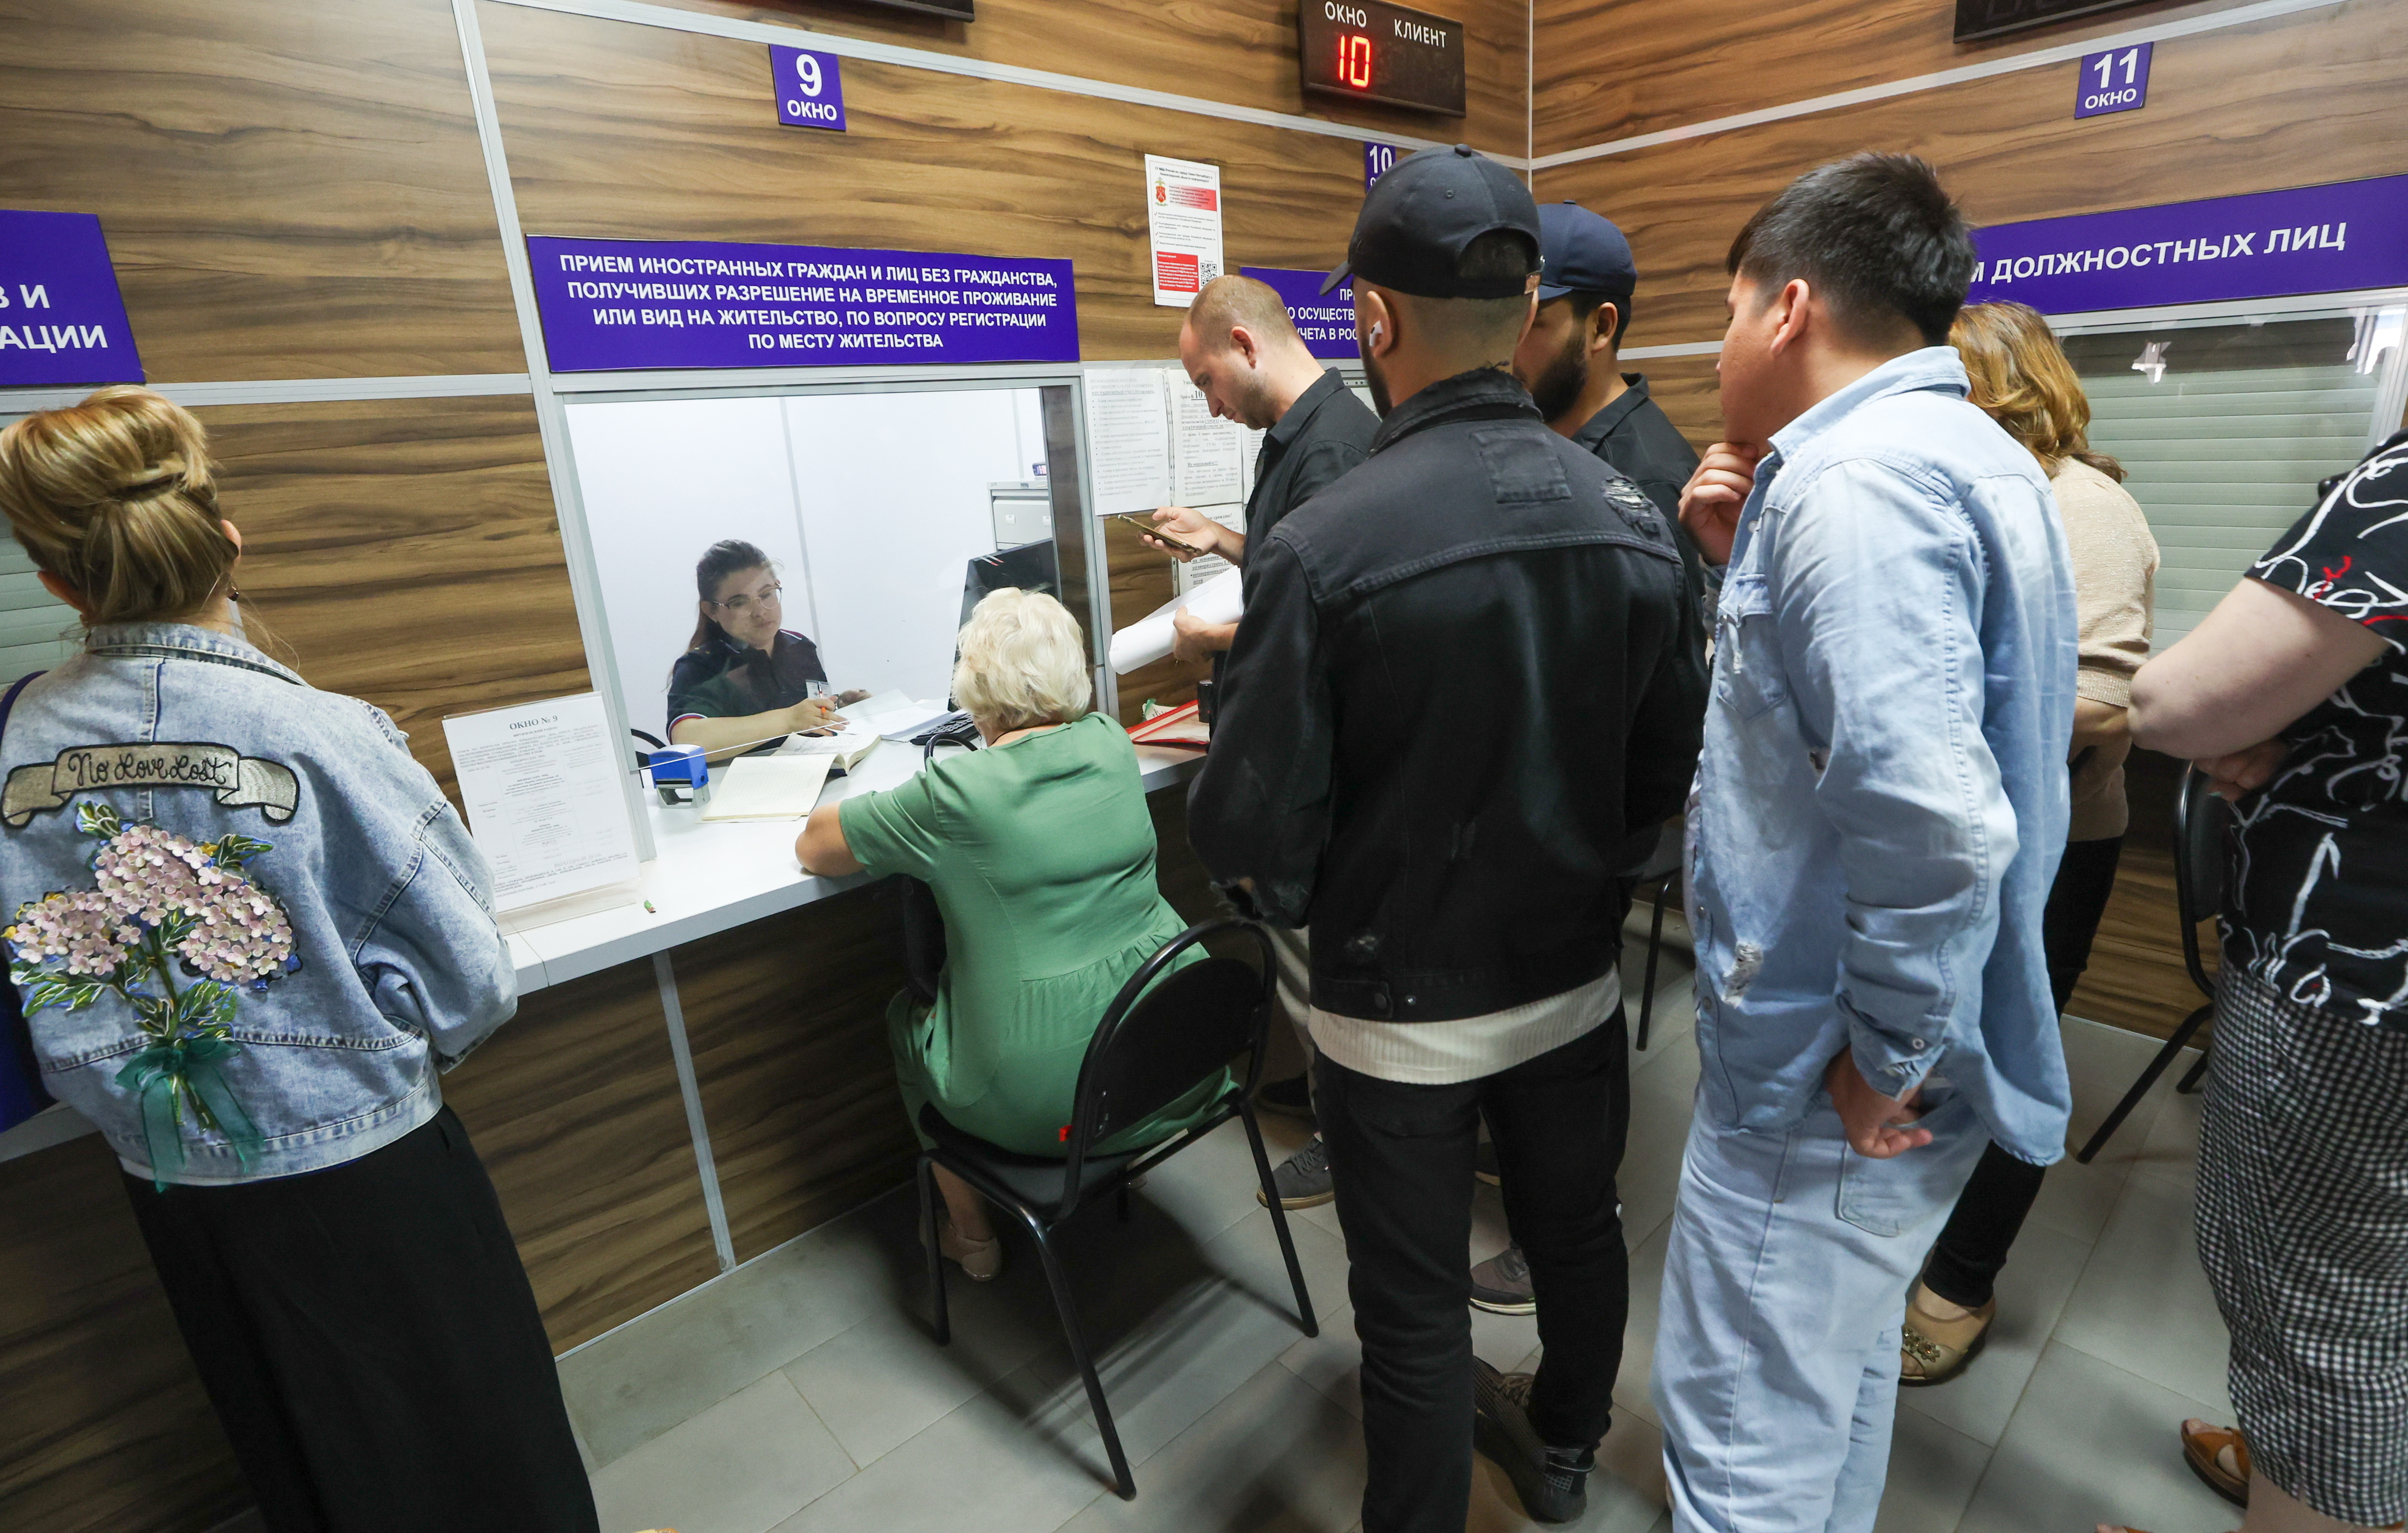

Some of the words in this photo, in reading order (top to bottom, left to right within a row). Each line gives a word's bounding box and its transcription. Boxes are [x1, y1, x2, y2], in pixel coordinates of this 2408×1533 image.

[1325, 1, 1367, 28] ОКНО
[1394, 18, 1447, 48] КЛИЕНТ
[1339, 35, 1370, 87] 10
[2094, 48, 2138, 89] 11
[796, 54, 822, 97] 9
[787, 99, 837, 121] ОКНО
[2085, 88, 2137, 109] ОКНО
[1370, 145, 1392, 173] 10
[1991, 233, 2256, 285] ДОЛЖНОСТНЫХ
[2263, 222, 2346, 254] ЛИЦ
[559, 254, 634, 273] ПРИЕМ
[638, 257, 784, 277] ИНОСТРАННЫХ
[787, 263, 867, 282] ГРАЖДАН
[870, 266, 882, 280] И
[886, 266, 918, 284] ЛИЦ
[921, 267, 951, 283] БЕЗ
[954, 269, 1057, 288] ГРАЖДАНСТВА,
[19, 284, 50, 308] И
[567, 282, 712, 300] ПОЛУЧИВШИХ
[715, 285, 835, 302] РАЗРЕШЕНИЕ
[839, 288, 863, 302] НА
[866, 288, 960, 305] ВРЕМЕННОЕ
[963, 291, 1057, 306] ПРОЖИВАНИЕ
[1340, 289, 1355, 301] ПР
[593, 308, 636, 325] ИЛИ
[641, 309, 684, 328] ВИД
[687, 309, 715, 325] НА
[717, 309, 843, 328] ЖИТЕЛЬСТВО,
[846, 311, 870, 326] ПО
[873, 311, 945, 326] ВОПРОСУ
[949, 312, 1046, 329] РЕГИСТРАЦИИ
[1285, 307, 1295, 320] О
[0, 325, 108, 353] АЦИИ
[748, 334, 775, 349] ПО
[778, 334, 835, 349] МЕСТУ
[838, 334, 944, 348] ЖИТЕЛЬСТВА
[1329, 328, 1336, 340] В
[1195, 390, 1203, 399] 10
[509, 719, 538, 730] ОКНО
[68, 752, 109, 787] No
[114, 753, 168, 780] Love
[169, 755, 232, 785] Lost
